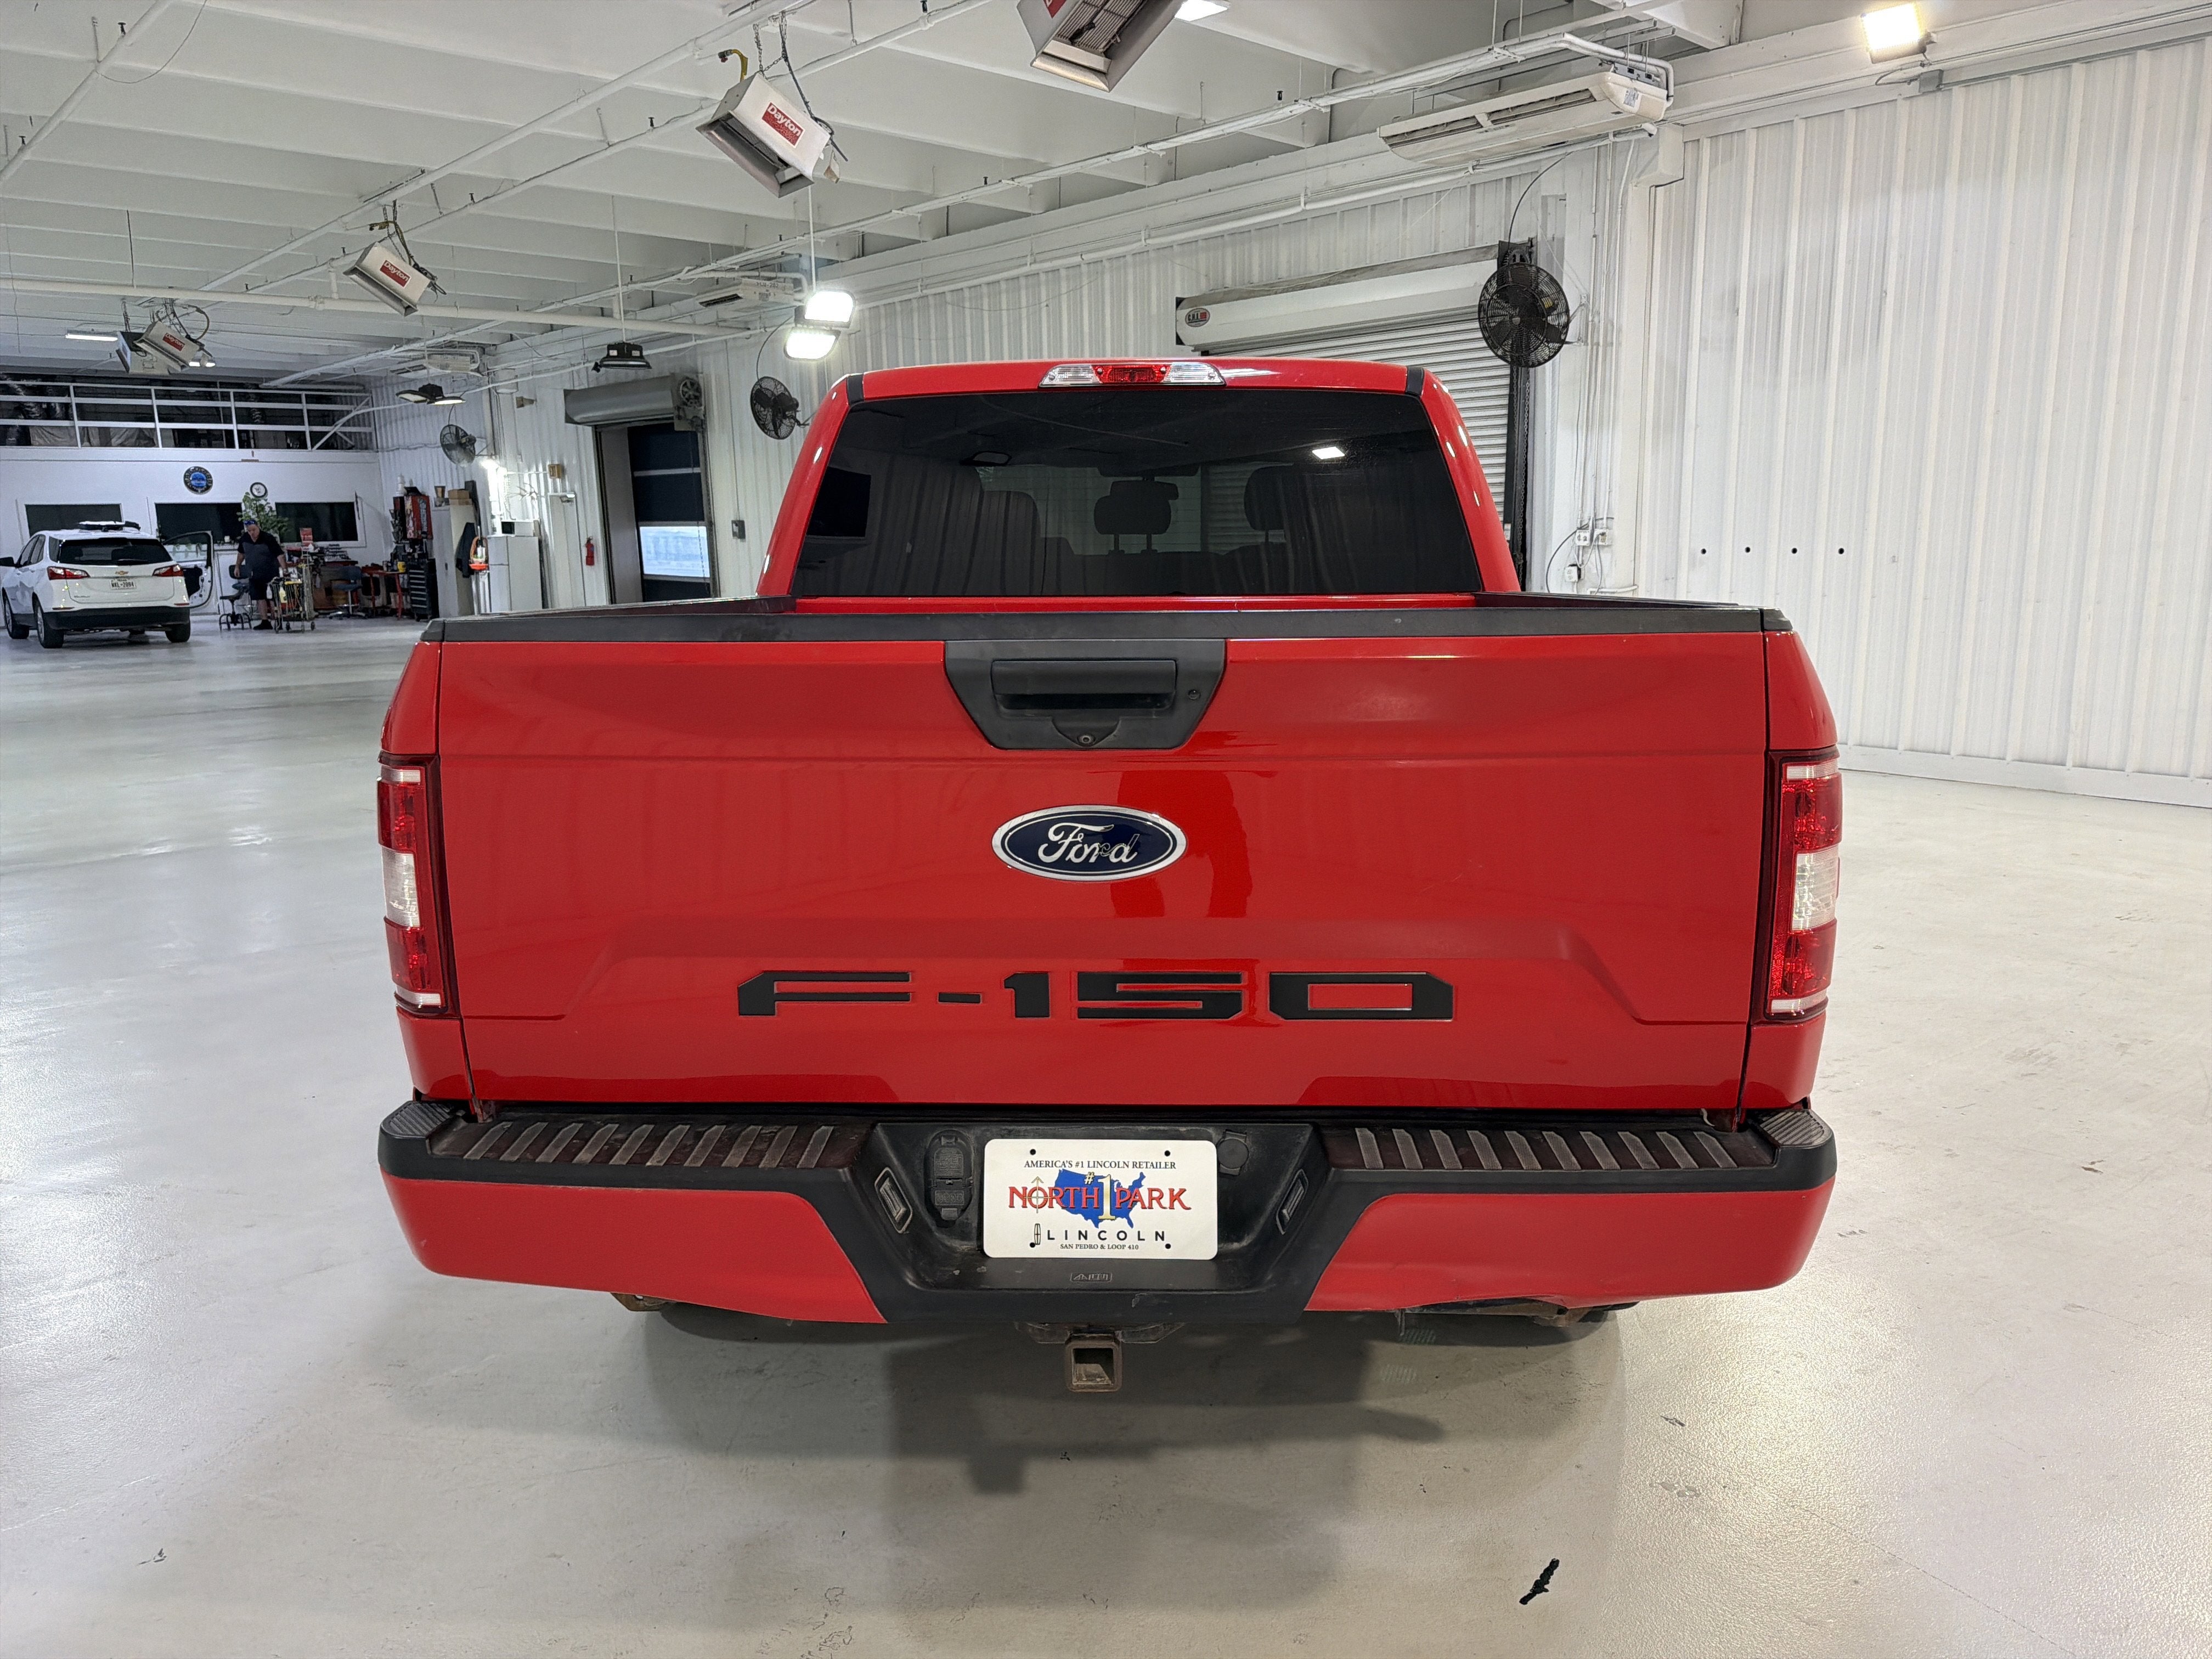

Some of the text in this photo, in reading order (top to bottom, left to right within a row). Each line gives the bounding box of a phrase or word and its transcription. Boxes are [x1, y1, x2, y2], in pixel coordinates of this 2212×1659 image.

[767, 104, 802, 137] Dayton
[383, 262, 409, 281] Dayton
[166, 334, 184, 347] Dayton
[1038, 822, 1140, 863] Ford
[737, 970, 1455, 1022] F-150
[1132, 1161, 1176, 1169] RETAILER
[1008, 1186, 1192, 1210] NORTH PARK
[1047, 1229, 1165, 1241] LINCOLN
